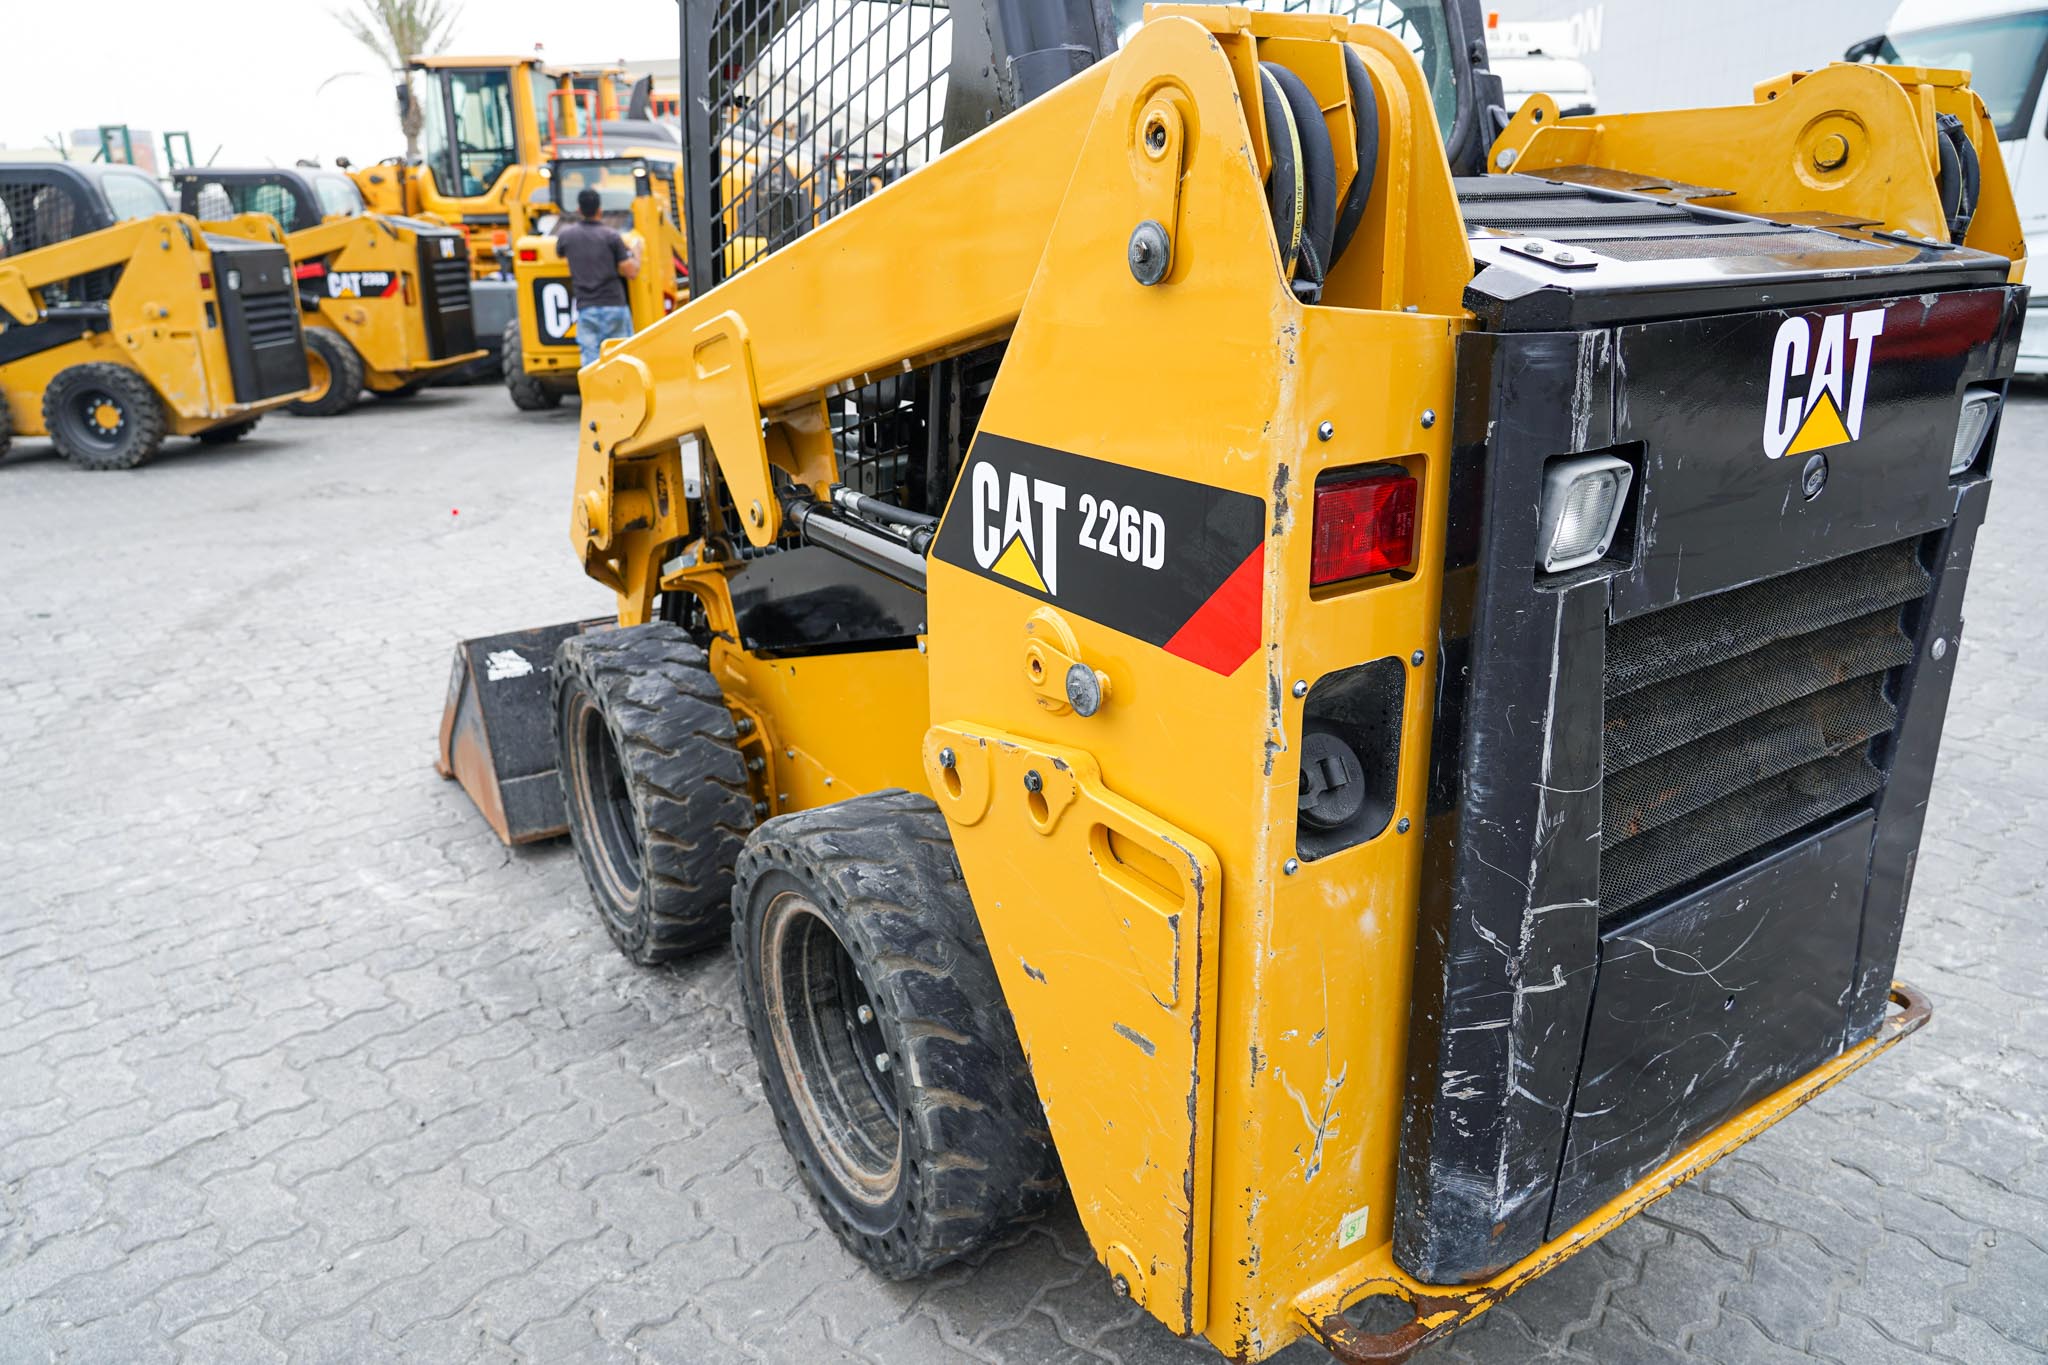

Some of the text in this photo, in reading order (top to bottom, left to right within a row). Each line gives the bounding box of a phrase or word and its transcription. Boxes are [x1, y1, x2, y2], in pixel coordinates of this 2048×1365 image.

[327, 272, 361, 298] CAT
[1763, 308, 1885, 460] CAT
[972, 461, 1165, 596] CAT 226D
